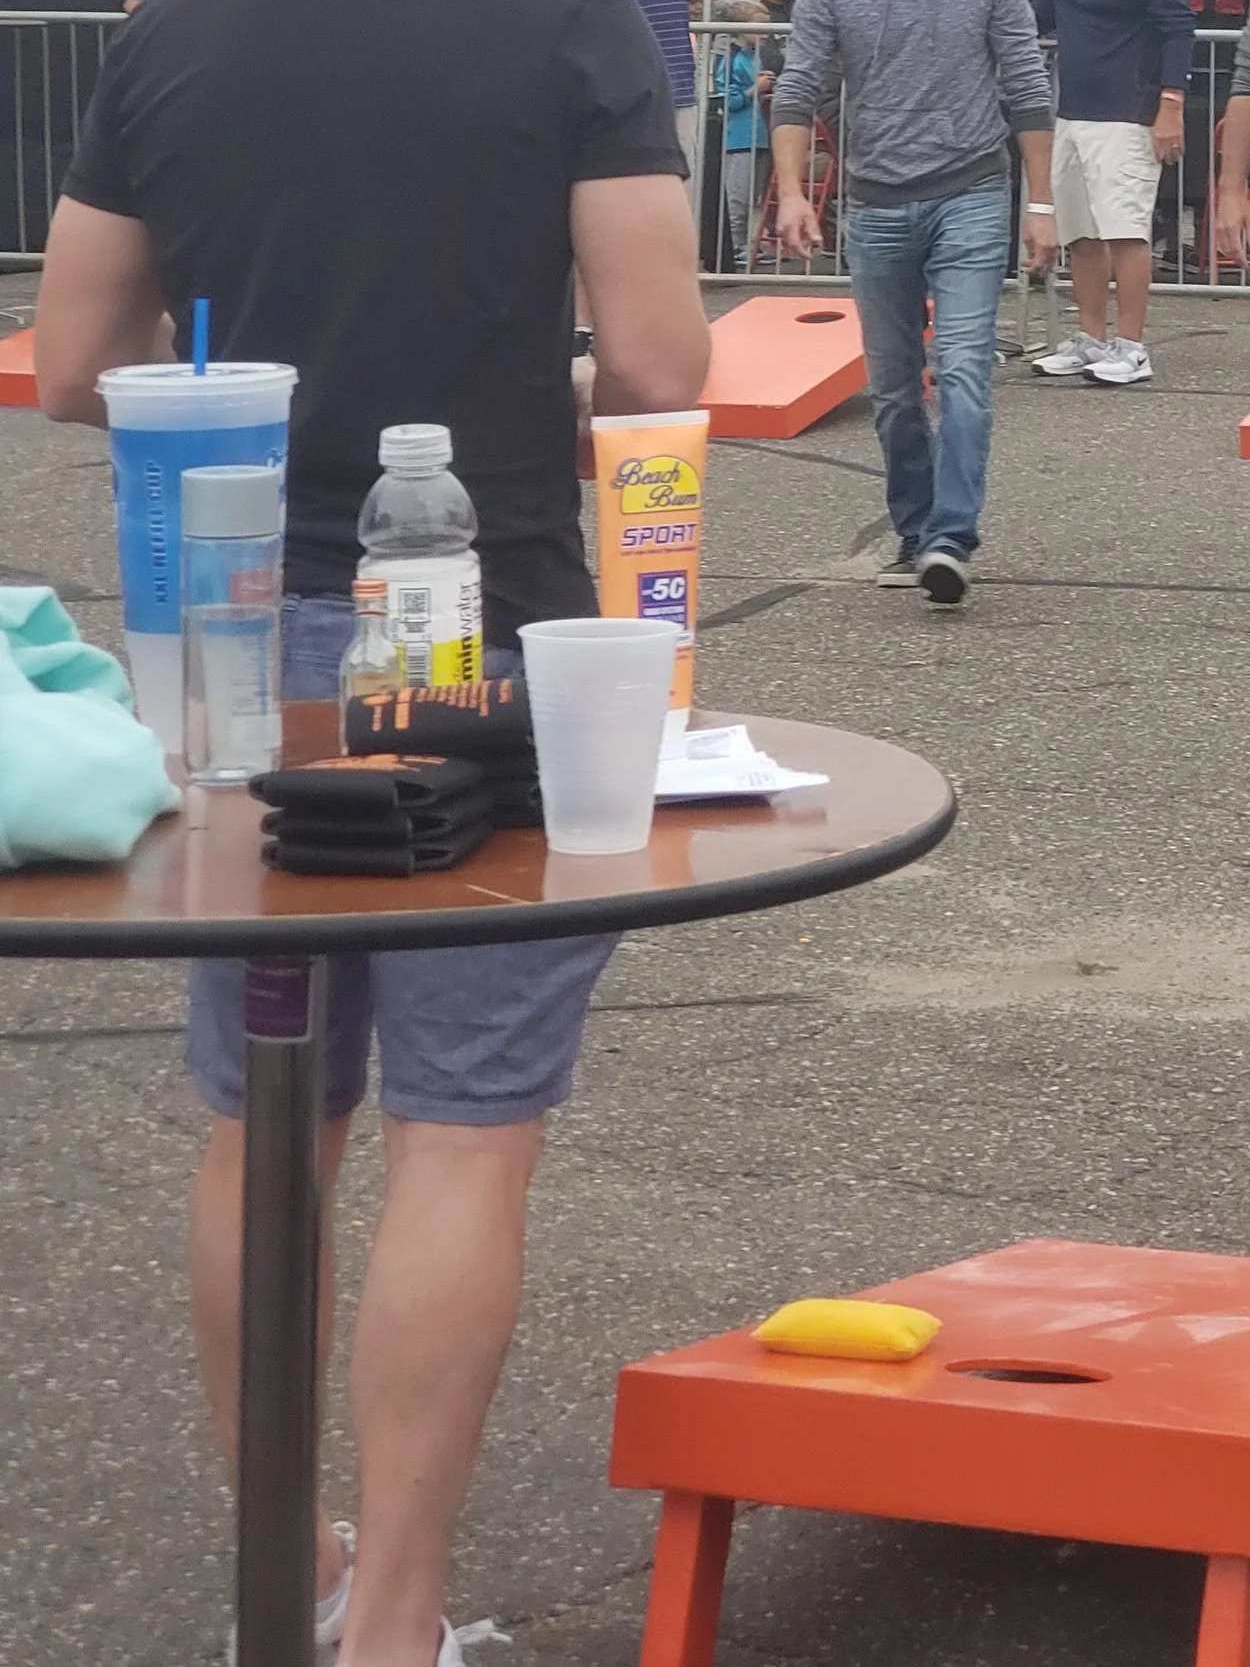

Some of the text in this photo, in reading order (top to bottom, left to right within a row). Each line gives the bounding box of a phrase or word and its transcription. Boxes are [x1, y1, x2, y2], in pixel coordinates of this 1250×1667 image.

[144, 460, 162, 501] CUP
[612, 458, 680, 489] Beach
[644, 485, 698, 508] Bum
[620, 522, 698, 549] SPORT
[455, 581, 473, 682] minwater
